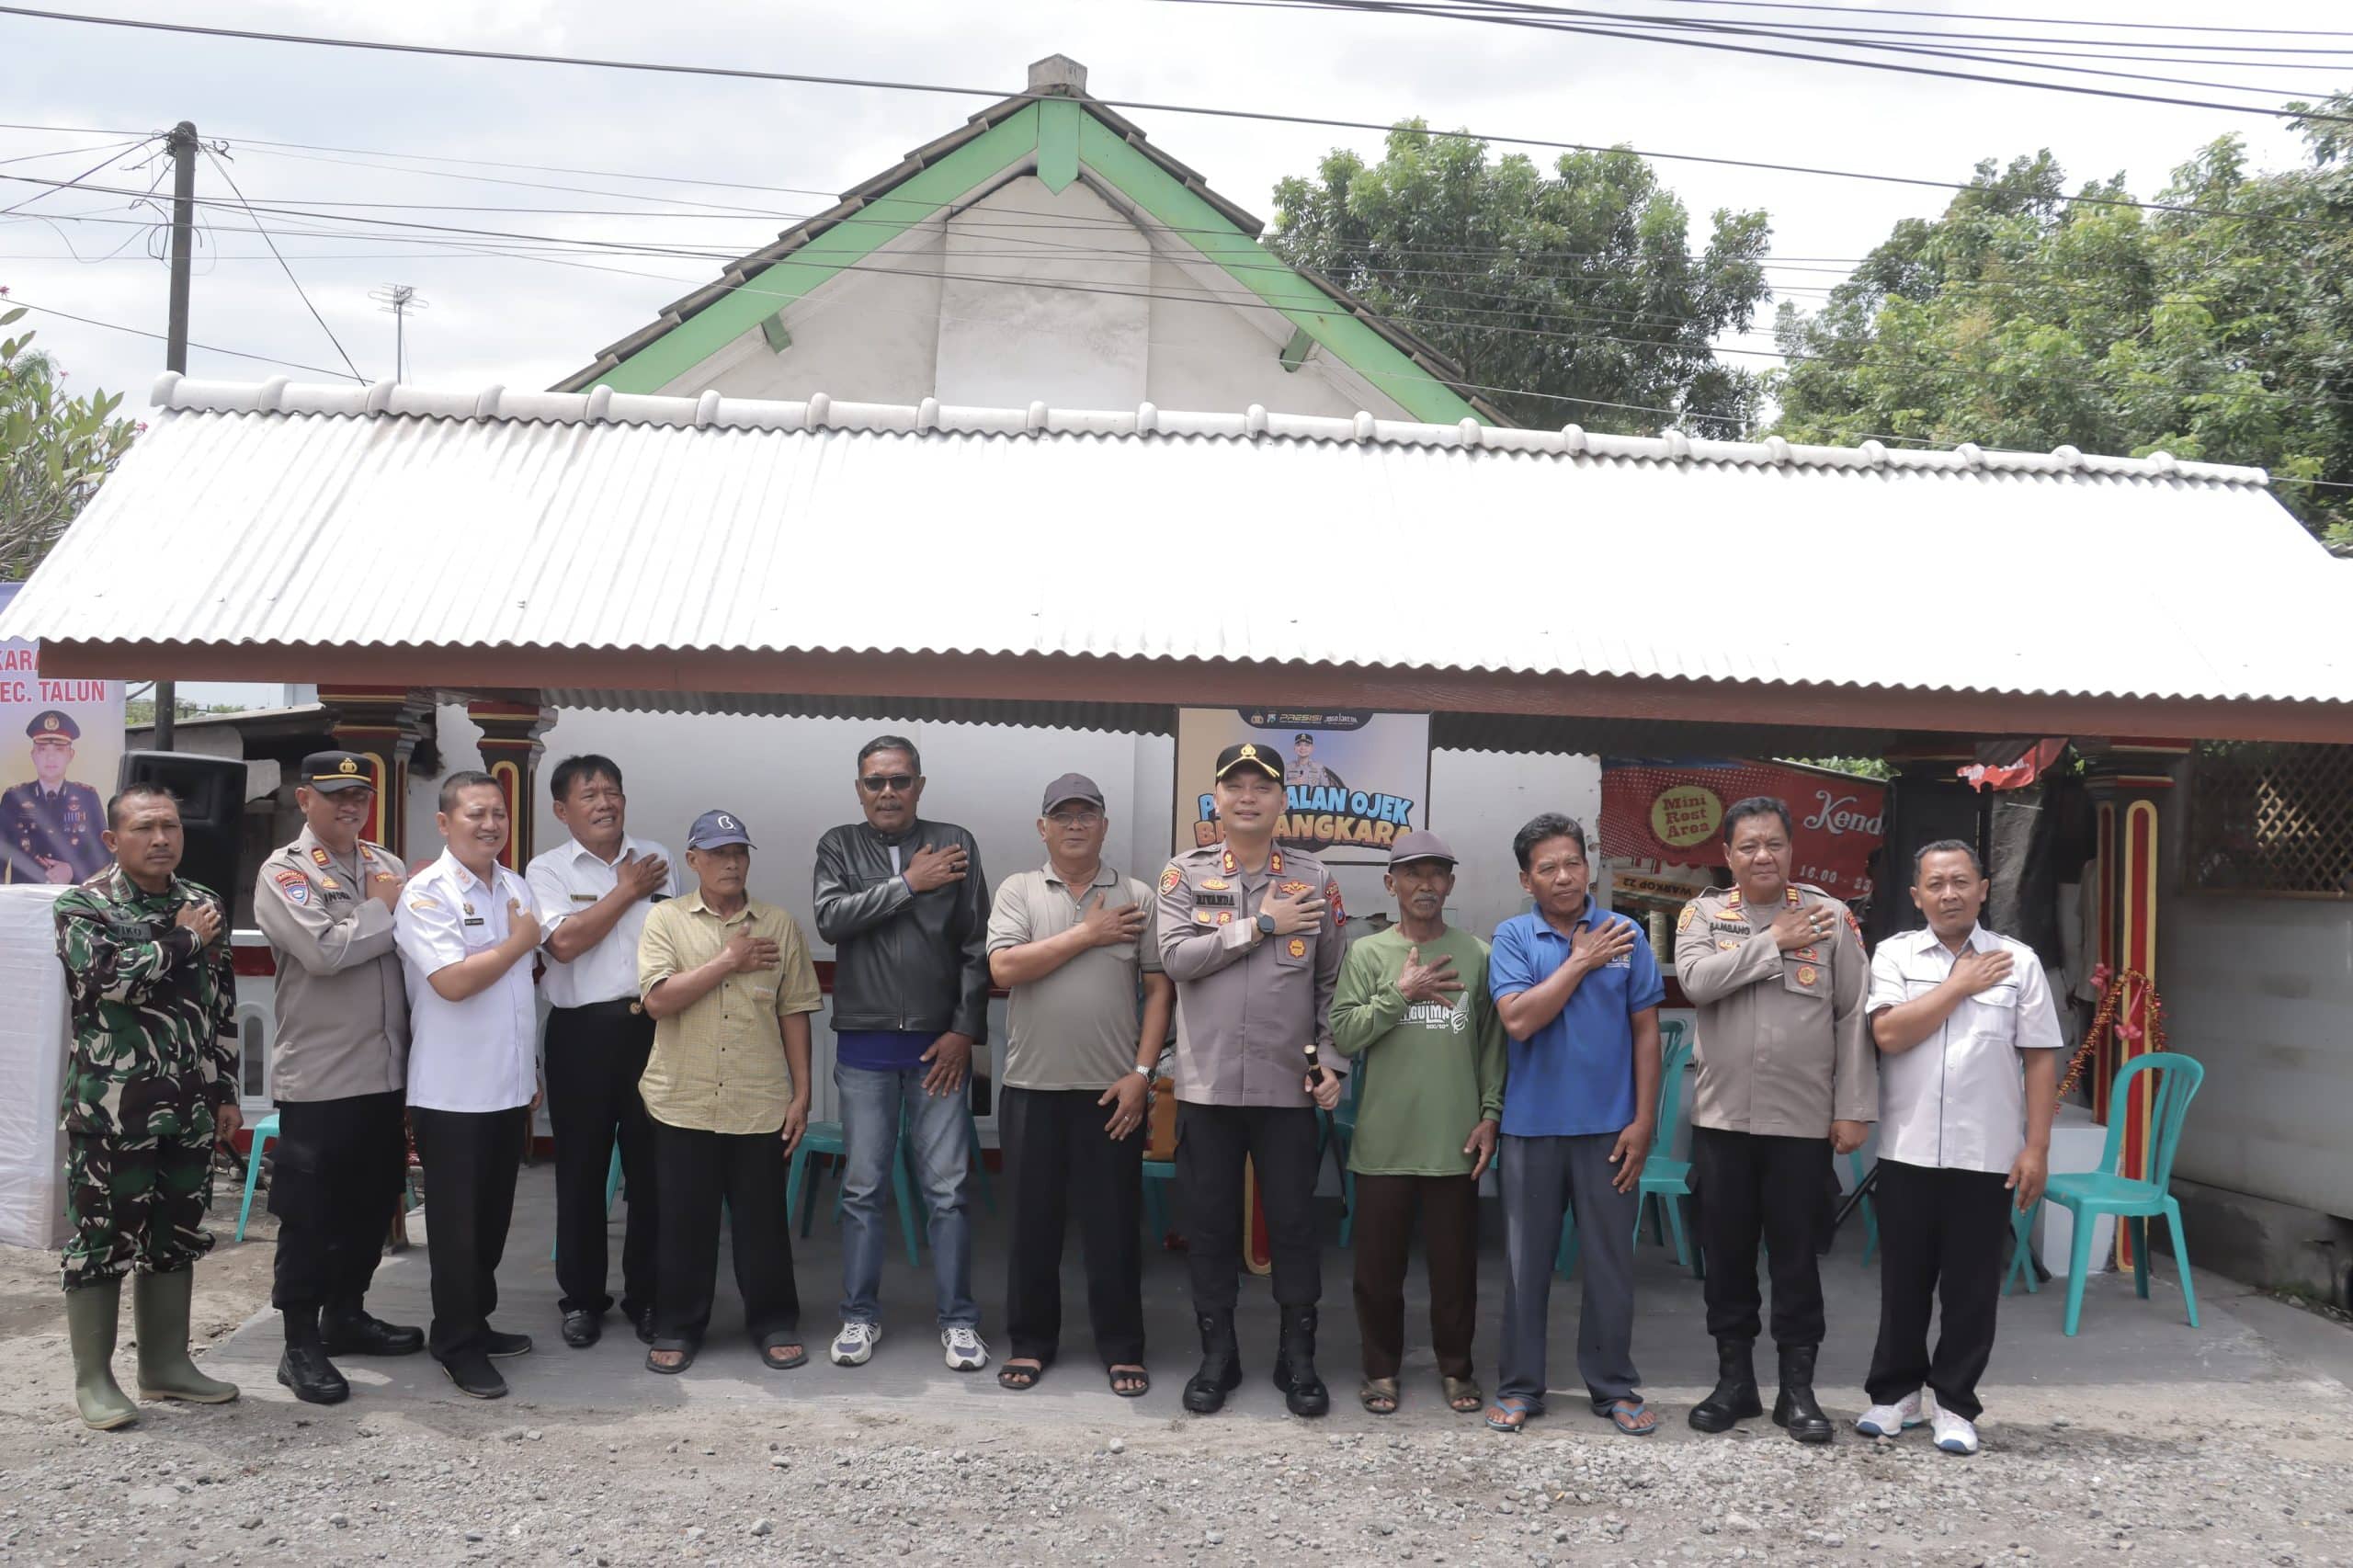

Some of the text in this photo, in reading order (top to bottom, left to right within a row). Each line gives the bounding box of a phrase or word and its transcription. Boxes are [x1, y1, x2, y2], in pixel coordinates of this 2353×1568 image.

[0, 681, 105, 702] EC. TALUN
[1199, 785, 1413, 825] PALAN OJEK
[1663, 794, 1707, 811] Mini
[1665, 809, 1707, 824] Rest
[1195, 814, 1412, 846] BANGKAR
[1667, 823, 1710, 838] Area
